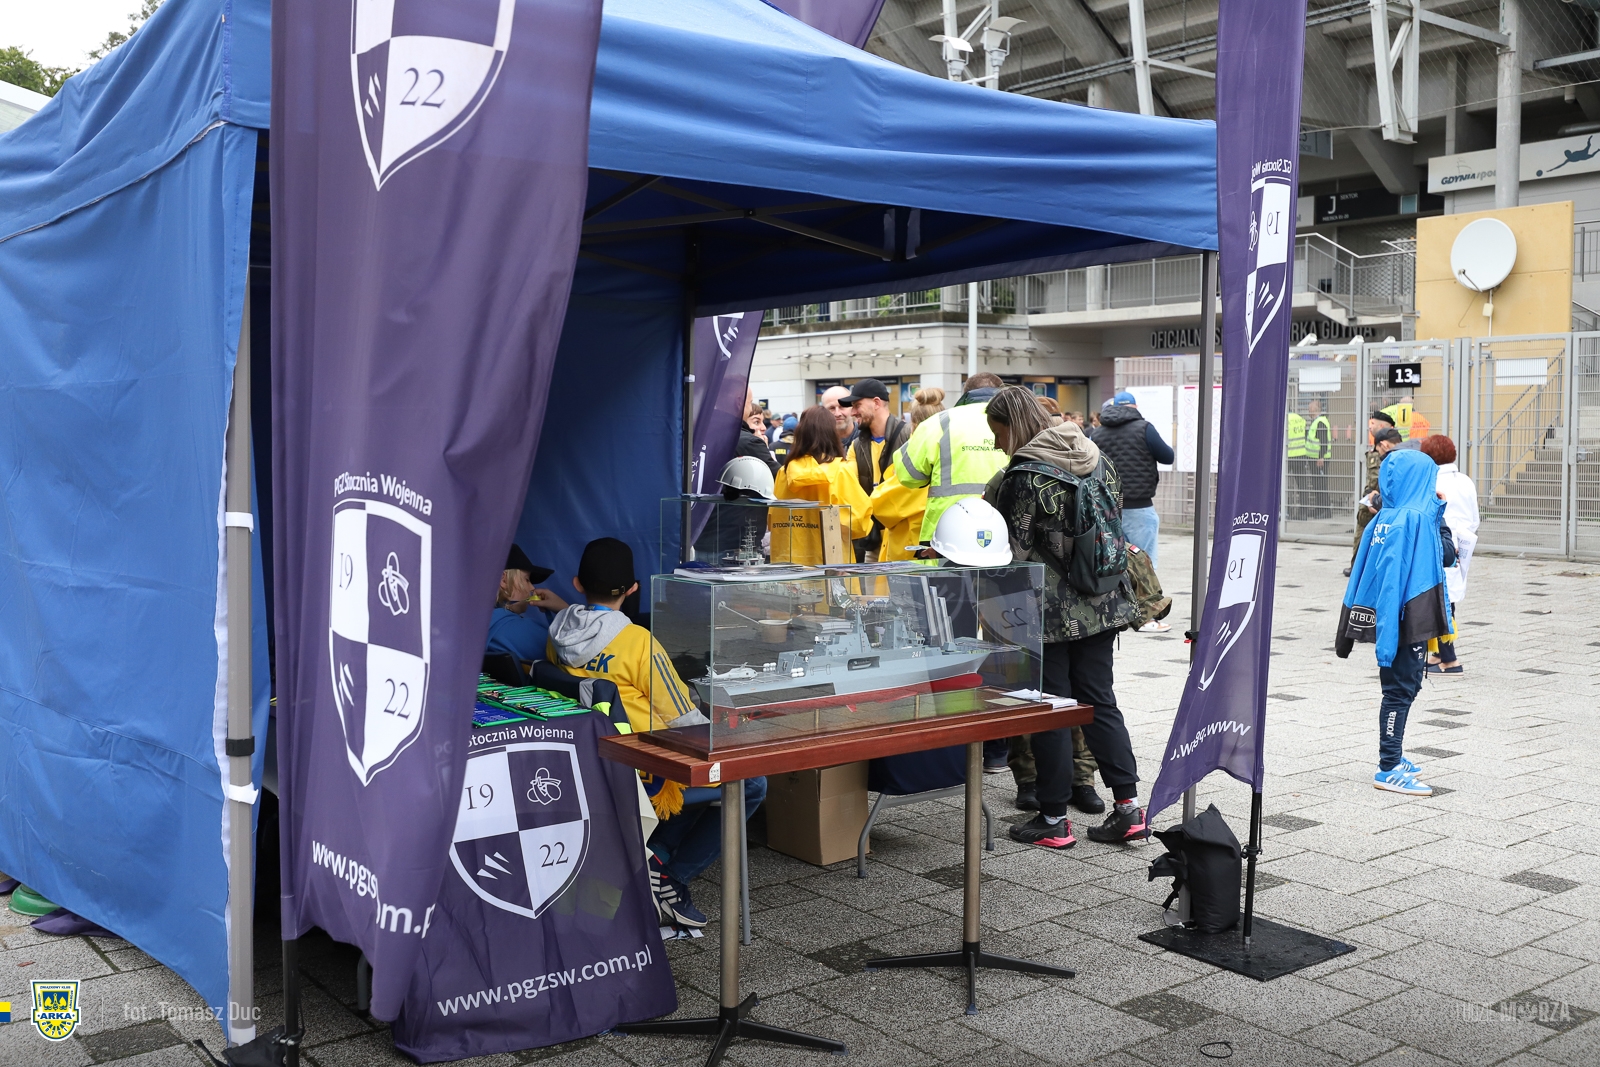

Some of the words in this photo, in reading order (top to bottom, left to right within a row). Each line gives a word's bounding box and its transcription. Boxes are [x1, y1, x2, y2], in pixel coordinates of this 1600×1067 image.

[399, 67, 446, 109] 22
[1441, 173, 1476, 186] GDYNIA
[1327, 195, 1336, 214] J
[1150, 328, 1202, 350] OFICJALN
[1214, 327, 1223, 345] S
[1291, 320, 1318, 342] RKA
[1395, 368, 1413, 383] 13
[983, 438, 995, 446] PG
[344, 471, 378, 494] Stocznia
[380, 473, 433, 516] Wojenna
[338, 552, 354, 591] 19
[585, 653, 616, 673] EK
[383, 677, 412, 720] 22
[519, 725, 574, 741] Wojenna
[464, 782, 495, 811] 19
[538, 840, 570, 869] 22
[437, 944, 653, 1017] www.pgzsw.com.pl
